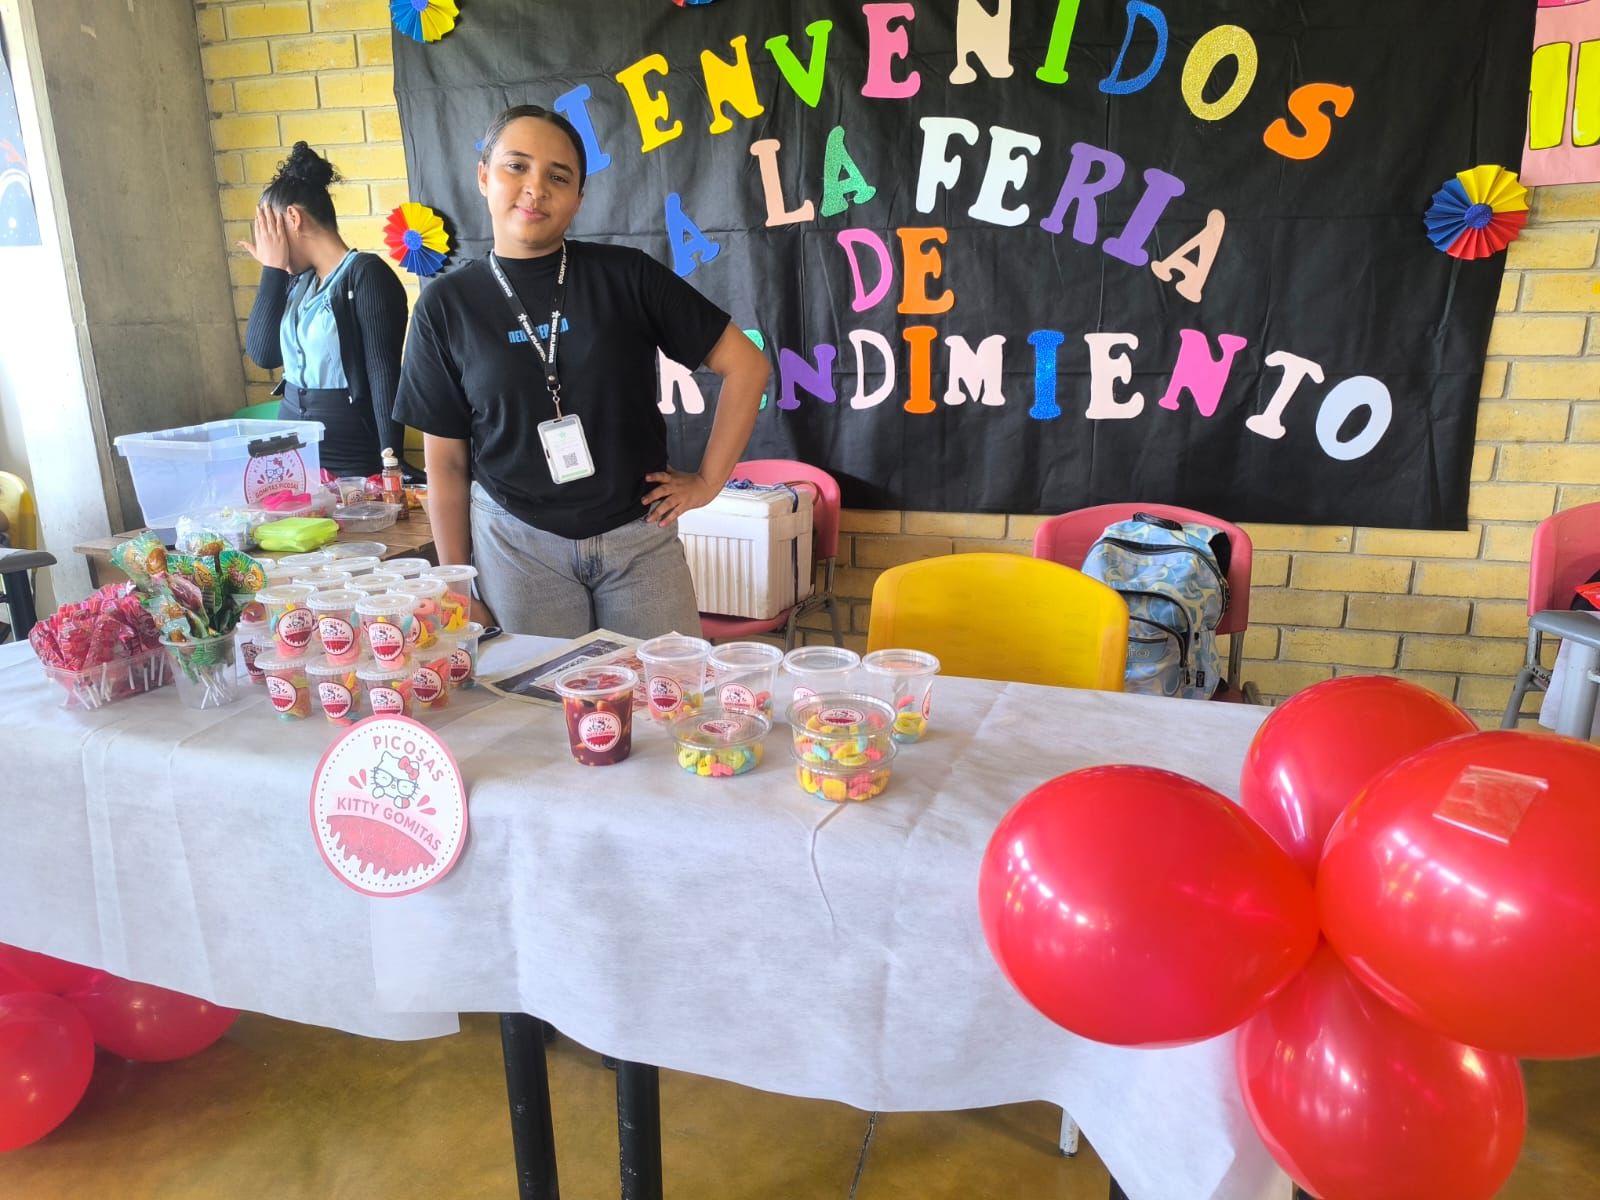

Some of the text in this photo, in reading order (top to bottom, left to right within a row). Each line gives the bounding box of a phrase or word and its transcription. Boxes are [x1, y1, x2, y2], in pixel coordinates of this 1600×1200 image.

[475, 0, 1354, 176] IENVENIDOS
[665, 117, 1225, 303] A LA FERIA
[837, 227, 954, 315] DE
[657, 325, 1392, 461] RNDIMIENTO
[373, 735, 444, 782] PICOSAS
[337, 797, 442, 850] KITTY GOMITAS
